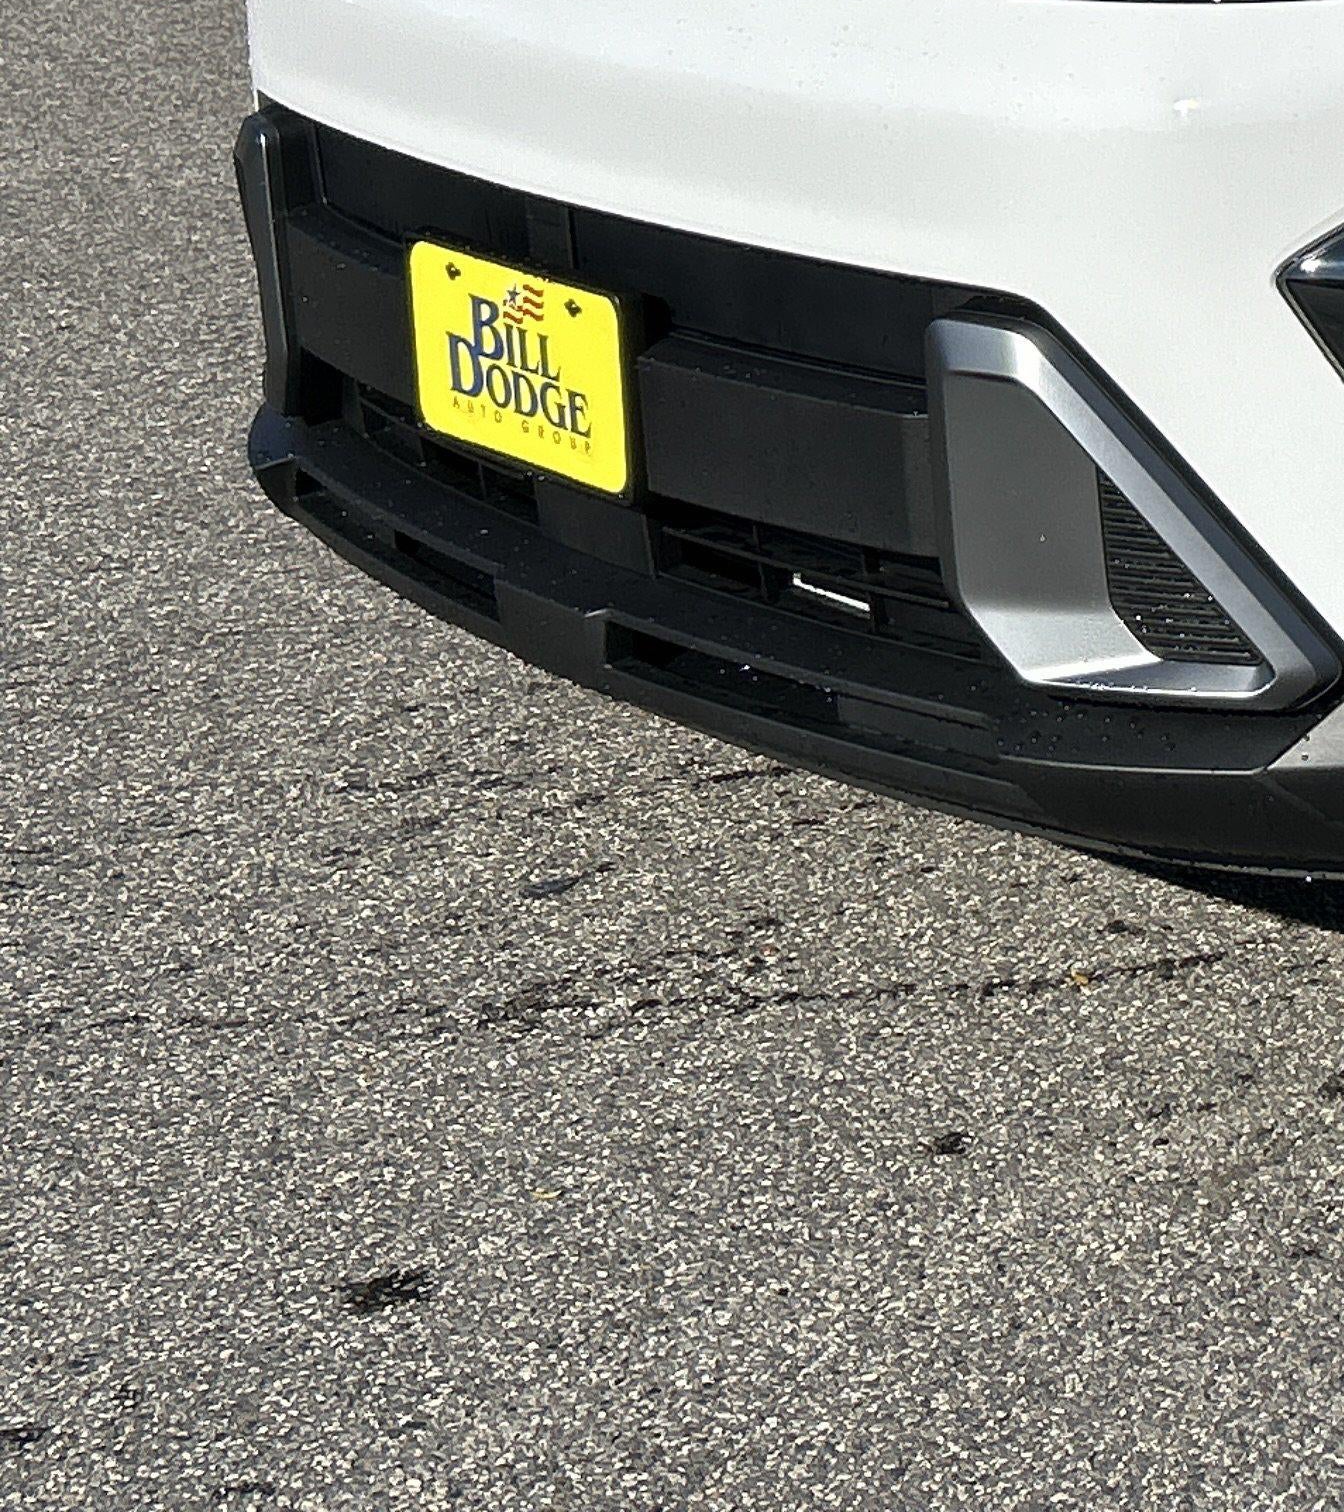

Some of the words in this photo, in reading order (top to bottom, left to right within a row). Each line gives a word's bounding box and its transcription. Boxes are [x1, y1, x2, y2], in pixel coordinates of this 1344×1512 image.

[468, 292, 561, 382] BILL
[446, 330, 592, 439] DODGE
[453, 395, 503, 424] AUTO
[521, 419, 591, 454] GROUP
